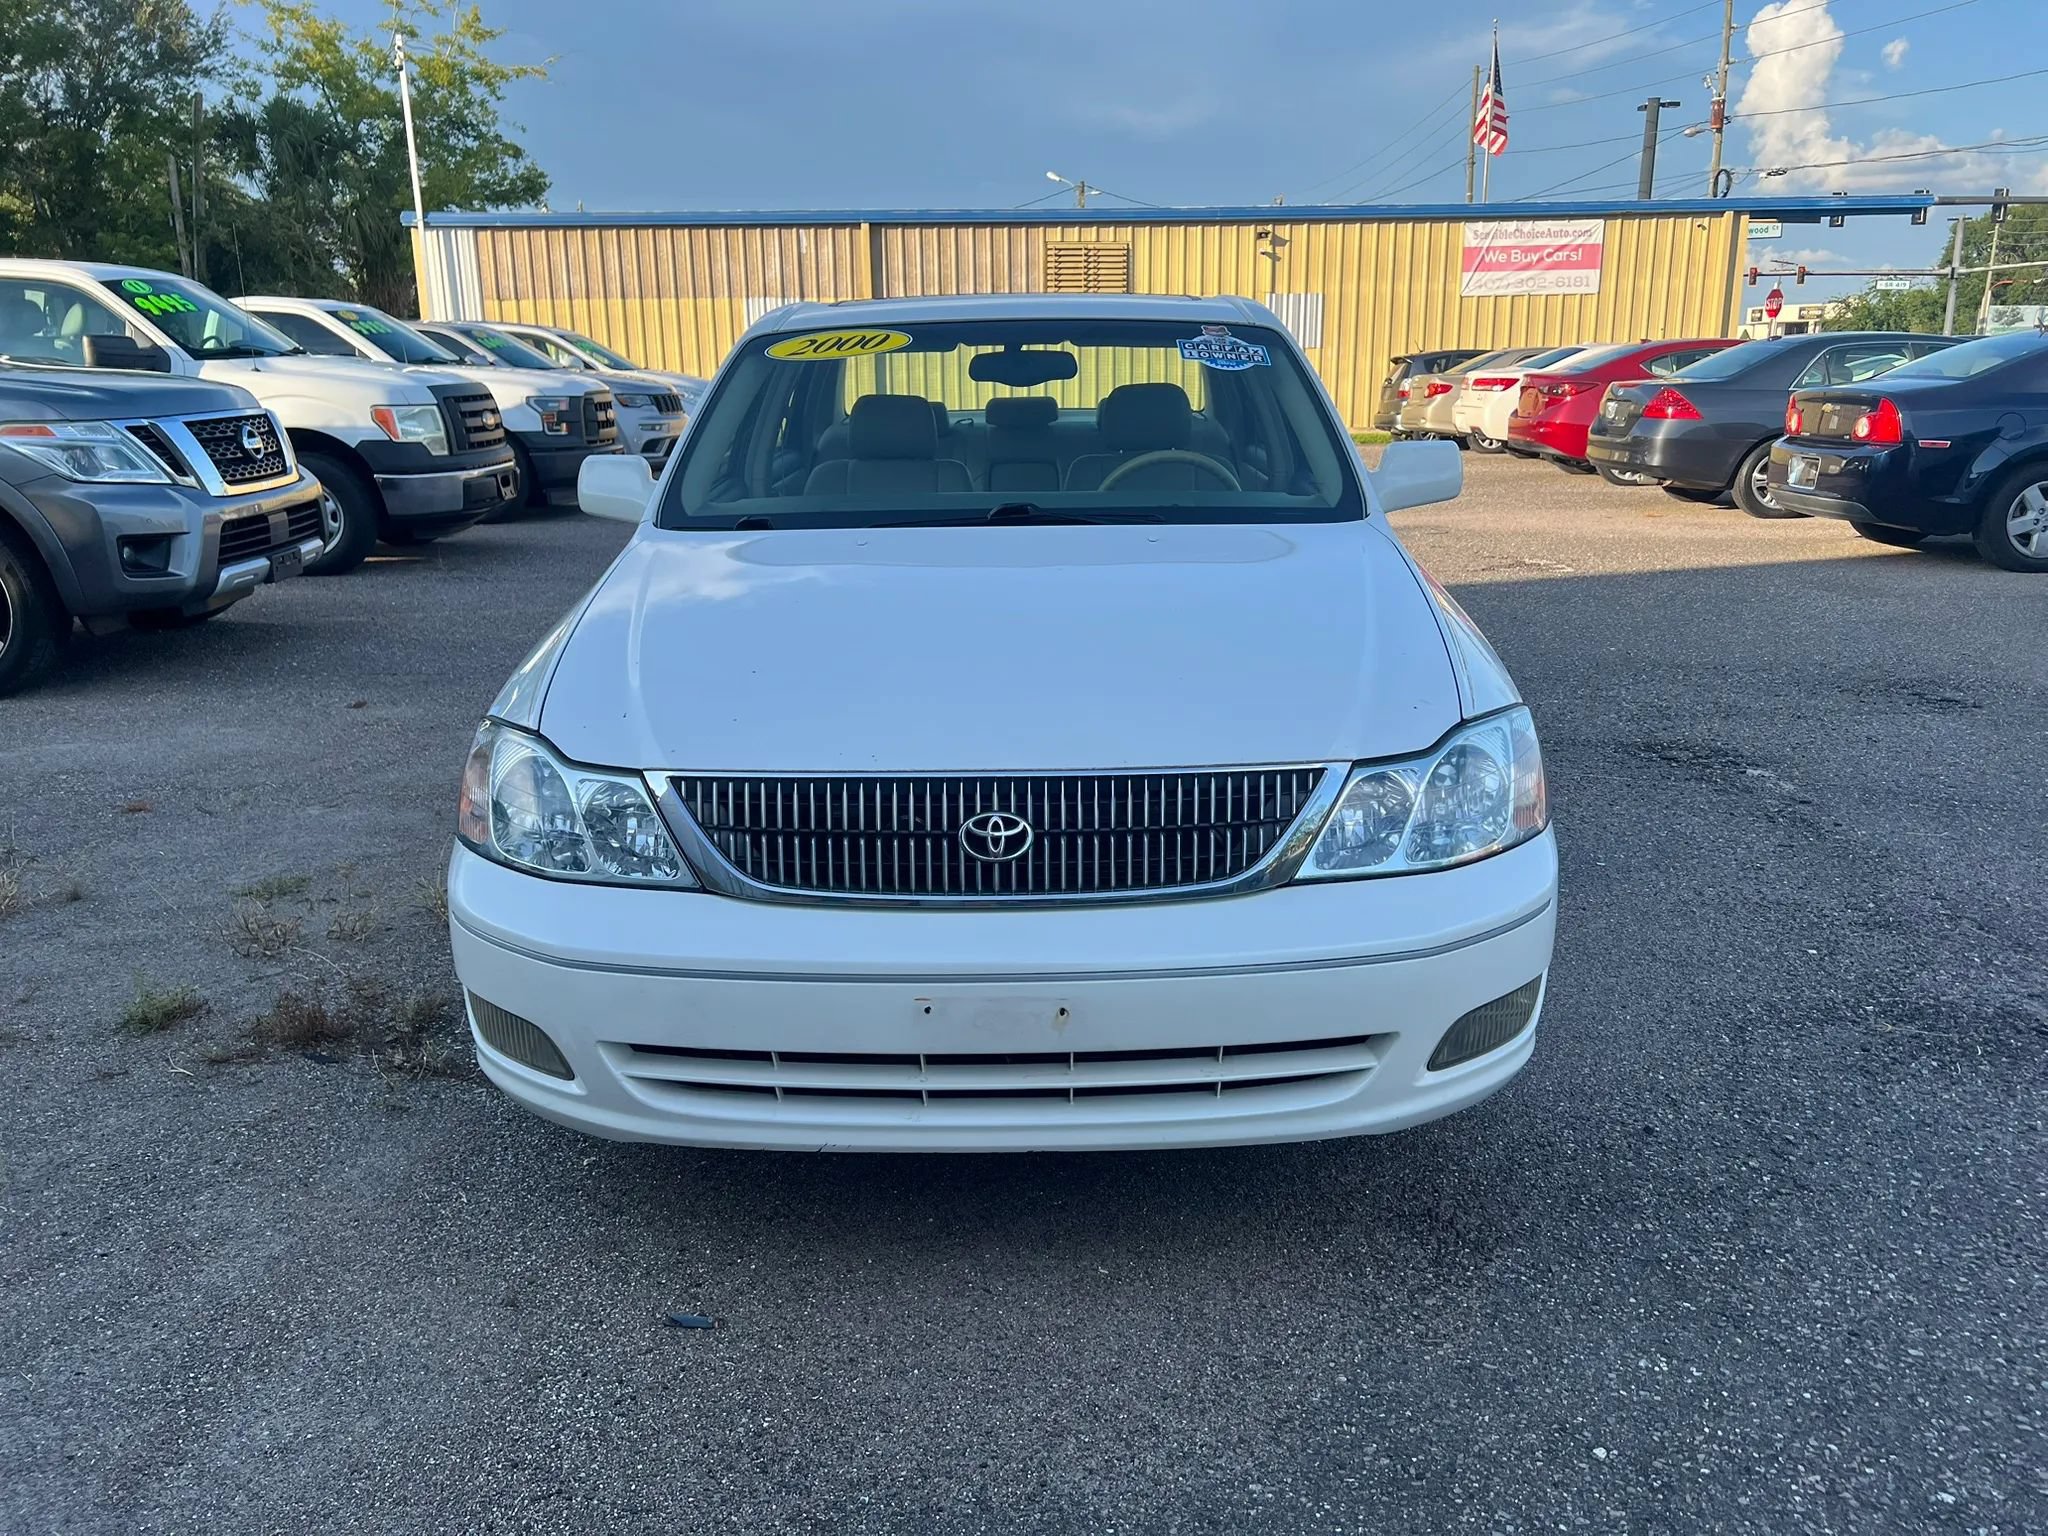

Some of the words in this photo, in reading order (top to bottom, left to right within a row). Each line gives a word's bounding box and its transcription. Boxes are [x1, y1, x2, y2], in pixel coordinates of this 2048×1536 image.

[1473, 228, 1593, 240] SenibleChoiceAuto.com
[1484, 250, 1507, 263] We
[1511, 249, 1539, 264] Buy
[1543, 248, 1583, 262] Cars!
[1766, 298, 1783, 310] STOP
[785, 333, 891, 357] 2000
[1184, 343, 1260, 355] CARFAX
[1199, 351, 1264, 362] OWNER
